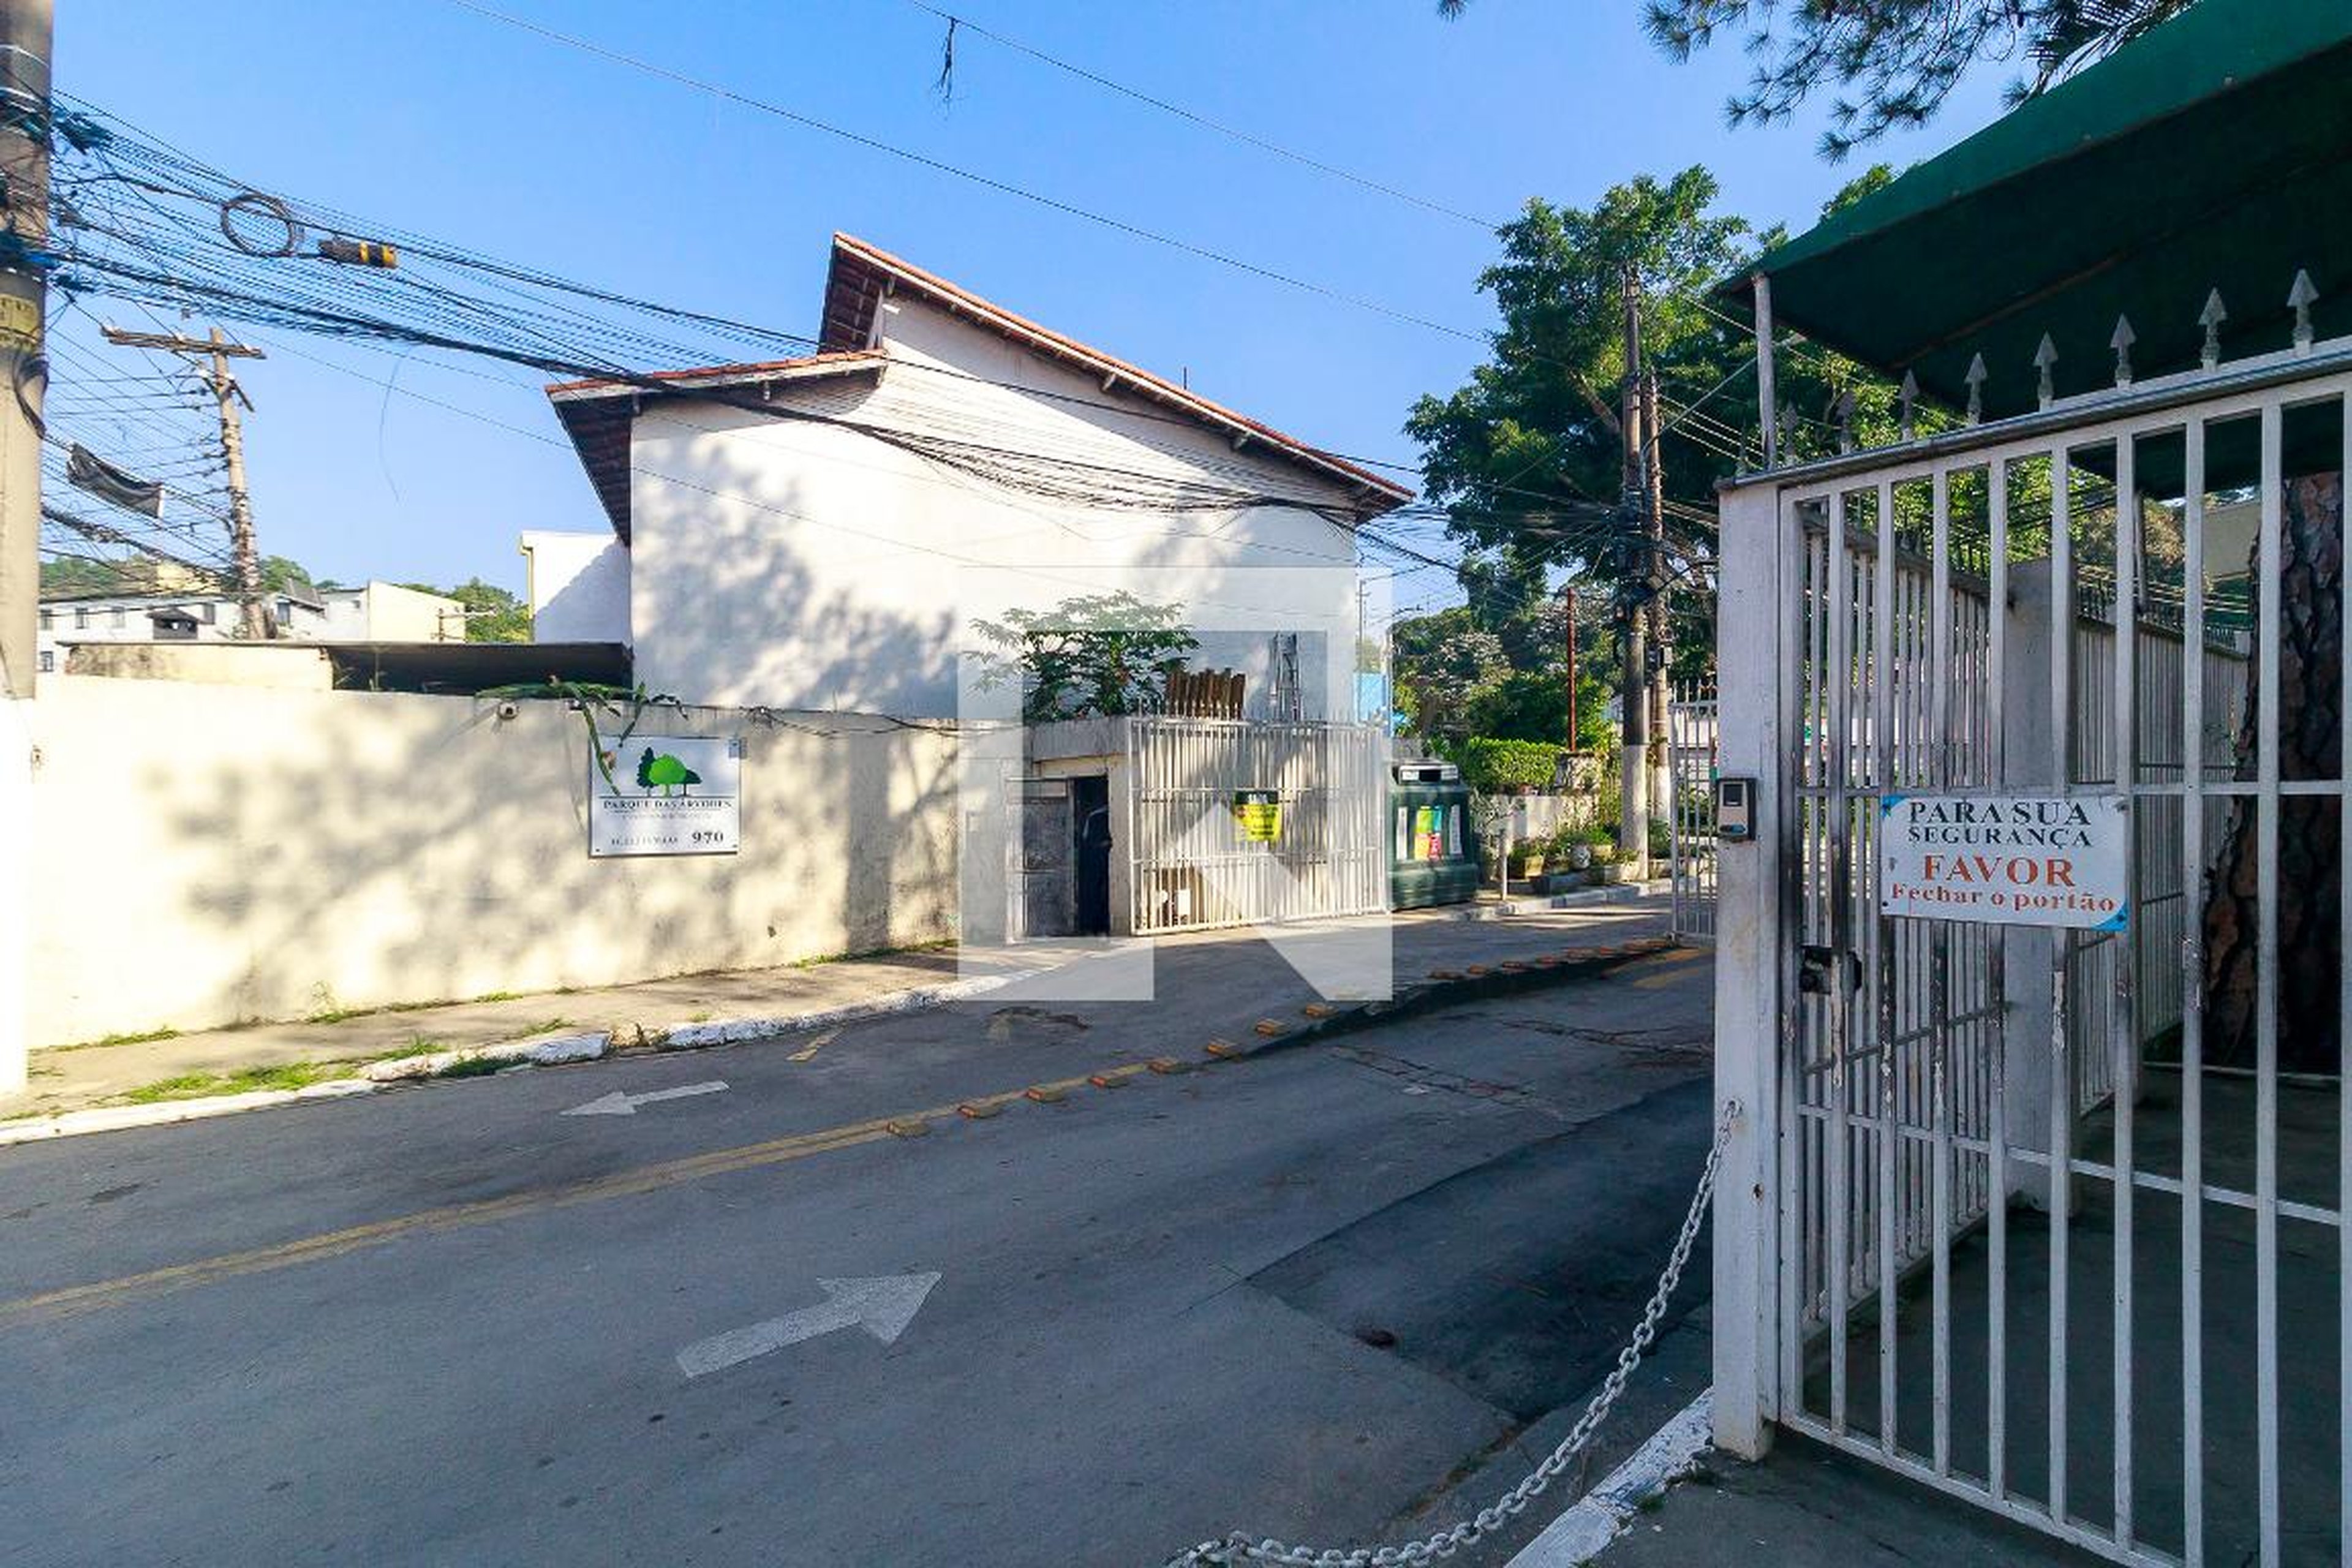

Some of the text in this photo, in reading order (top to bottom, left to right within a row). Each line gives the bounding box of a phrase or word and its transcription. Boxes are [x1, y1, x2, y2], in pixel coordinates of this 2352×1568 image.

[604, 800, 649, 809] PARQUE
[1909, 802, 2092, 826] PARA SUA
[692, 831, 724, 845] 970
[1909, 826, 2092, 850] SEGURANÇA
[1922, 855, 2076, 886] FAVOR
[1893, 883, 2114, 911] Fechar o portão
